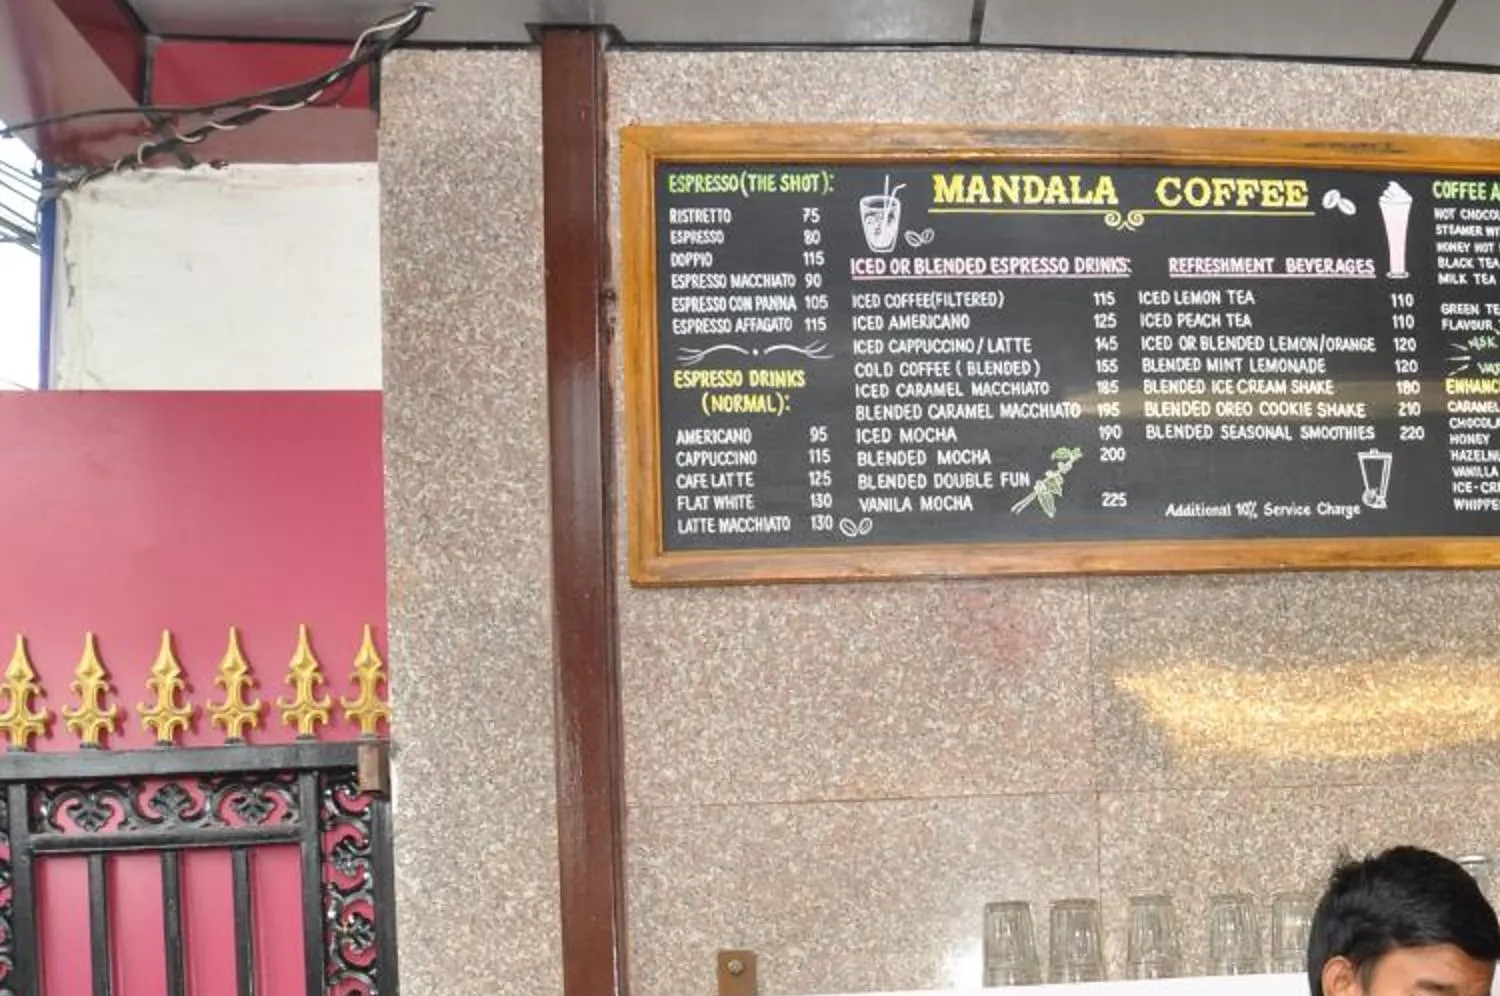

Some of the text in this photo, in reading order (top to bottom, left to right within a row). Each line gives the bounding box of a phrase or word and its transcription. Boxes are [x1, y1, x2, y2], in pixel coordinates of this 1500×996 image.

[932, 174, 1308, 208] MANDALA COFFEE
[1432, 182, 1486, 199] COFFEE
[669, 208, 820, 223] RISTRETTO 75
[670, 230, 820, 245] ESPRESSO 80
[1436, 227, 1483, 237] STEAMER
[671, 251, 825, 267] DOPPIO 115
[850, 258, 886, 275] ICED
[890, 258, 910, 275] OR
[914, 258, 986, 275] BLENDED
[990, 258, 1069, 274] ESPRESSO
[1168, 258, 1375, 274] REFRESHMENT BEVERAGES
[1438, 257, 1500, 269] BLACK TEA
[672, 274, 822, 289] ESPRESSO MACCHIATO 90
[1438, 273, 1467, 284] MILK
[1473, 274, 1497, 285] TEA
[672, 295, 828, 312] ESPRESSO CON PANNA 105
[852, 292, 880, 308] ICED
[1093, 292, 1116, 306] 115
[1138, 290, 1414, 308] ICED LEMON TEA 110
[1440, 304, 1479, 315] GREEN
[672, 317, 827, 334] ESPRESSO AFFAGATO 115
[852, 312, 1116, 331] ICED AMERICANO 125
[1140, 313, 1414, 329] ICED PEACH TEA 110
[1441, 319, 1493, 331] FLAVOUR
[853, 338, 884, 354] ICED
[1095, 336, 1118, 352] 145
[1141, 336, 1172, 351] ICED
[1178, 336, 1198, 351] OR
[1201, 336, 1264, 350] BLENDED
[1393, 338, 1416, 351] 120
[854, 362, 892, 378] COLD
[900, 362, 951, 378] COFFEE
[1096, 359, 1118, 374] 155
[1142, 358, 1418, 373] BLENDED MINT LEMONADE 120
[673, 370, 806, 388] ESPRESSO DRINKS
[1144, 379, 1420, 394] BLENDED ICE CREAM SHAKE 180
[856, 380, 1120, 399] ICED CARAMEL MACCHIATO 185
[856, 401, 1120, 420] BLENDED CARAMEL MACCHIATO 195
[1144, 401, 1421, 418] BLENDED OREO COOKIE SHAKE 210
[1448, 402, 1500, 413] CARAMEL
[676, 426, 828, 445] AMERICANO 95
[856, 424, 1122, 444] ICED MOCHA 190
[1146, 424, 1424, 440] BLENDED SEASONAL SMOOTHIES 220
[1450, 434, 1490, 445] HONEY
[676, 449, 831, 466] CAPPUCCINO 115
[857, 448, 1126, 466] BLENDED MOCHA 200
[676, 471, 832, 489] CAFE LATTE 125
[1452, 466, 1499, 477] VANILLA
[858, 472, 1031, 490] BLENDED DOUBLE FUN
[677, 493, 832, 511] FLAT WHITE 130
[859, 492, 1127, 512] VANILA MOCHA 225
[1166, 502, 1232, 517] Additional
[1264, 502, 1313, 516] Service
[1317, 502, 1361, 520] Charge
[678, 515, 833, 534] LATTE MACCHIATO 130
